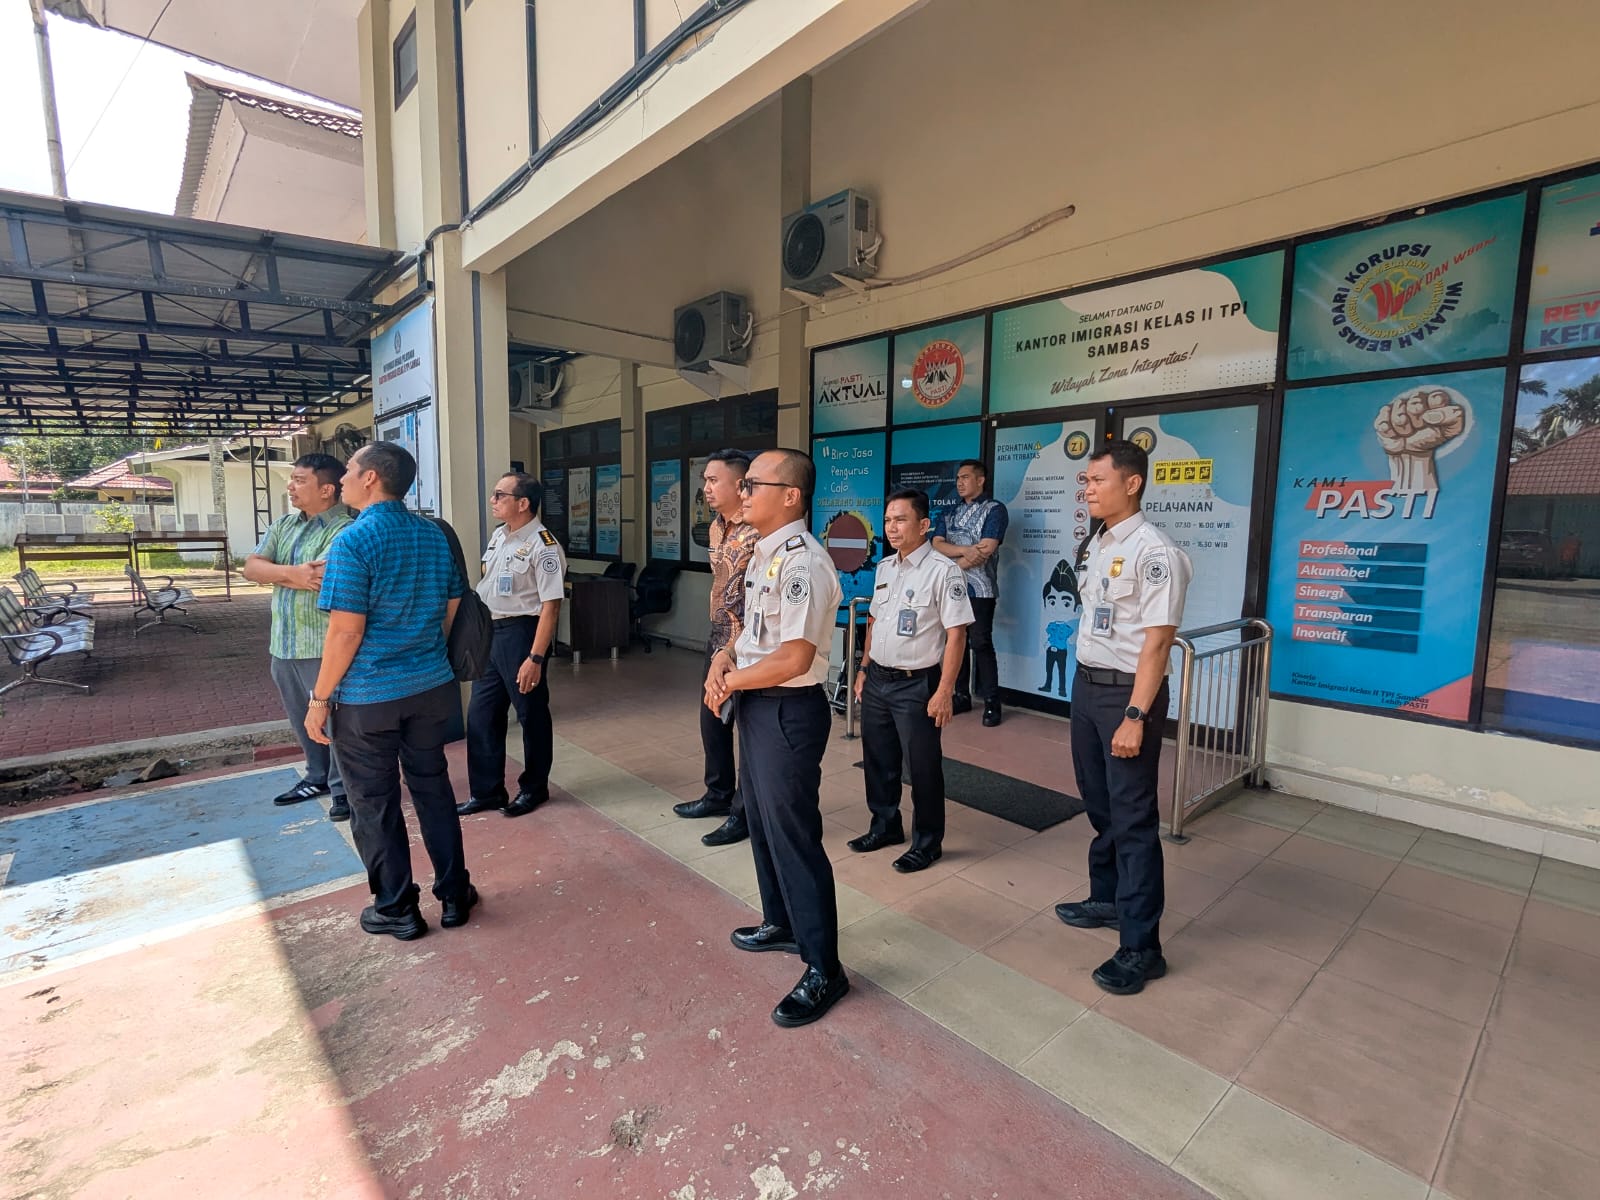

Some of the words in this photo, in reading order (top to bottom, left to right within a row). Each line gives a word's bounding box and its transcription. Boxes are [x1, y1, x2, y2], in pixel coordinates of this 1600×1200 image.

[1345, 244, 1432, 284] KORUPSI
[1425, 260, 1449, 286] DAN
[1079, 310, 1116, 324] SELAMAT
[1117, 302, 1152, 320] DATANG
[1152, 300, 1164, 310] DI
[1331, 287, 1350, 326] DARI
[1399, 281, 1463, 348] WILAYAH
[1016, 334, 1066, 352] KANTOR
[1071, 322, 1138, 344] IMIGRASI
[1144, 310, 1196, 331] KELAS
[1201, 307, 1213, 321] II
[1220, 300, 1248, 318] TPI
[1338, 326, 1392, 352] BEBAS
[1088, 338, 1150, 358] SAMBAS
[1050, 372, 1096, 395] Wilayah
[1098, 366, 1128, 384] Zona
[1130, 343, 1199, 376] Integritas!
[818, 380, 884, 404] AKTUAL
[830, 448, 849, 460] Biro
[852, 447, 873, 459] Jasa
[997, 442, 1032, 452] PERHATIAN
[830, 466, 870, 480] Pengurus
[830, 481, 849, 493] Calo
[1294, 476, 1348, 488] KAMI
[1146, 502, 1213, 512] PELAYANAN
[1316, 488, 1439, 519] PASTI
[1302, 543, 1378, 556] Profesional
[1300, 565, 1370, 578] Akuntabel
[1298, 586, 1344, 600] Sinergi
[1298, 606, 1373, 622] Transparan
[1296, 626, 1348, 642] Inovatif
[1318, 682, 1348, 692] Imigrasi
